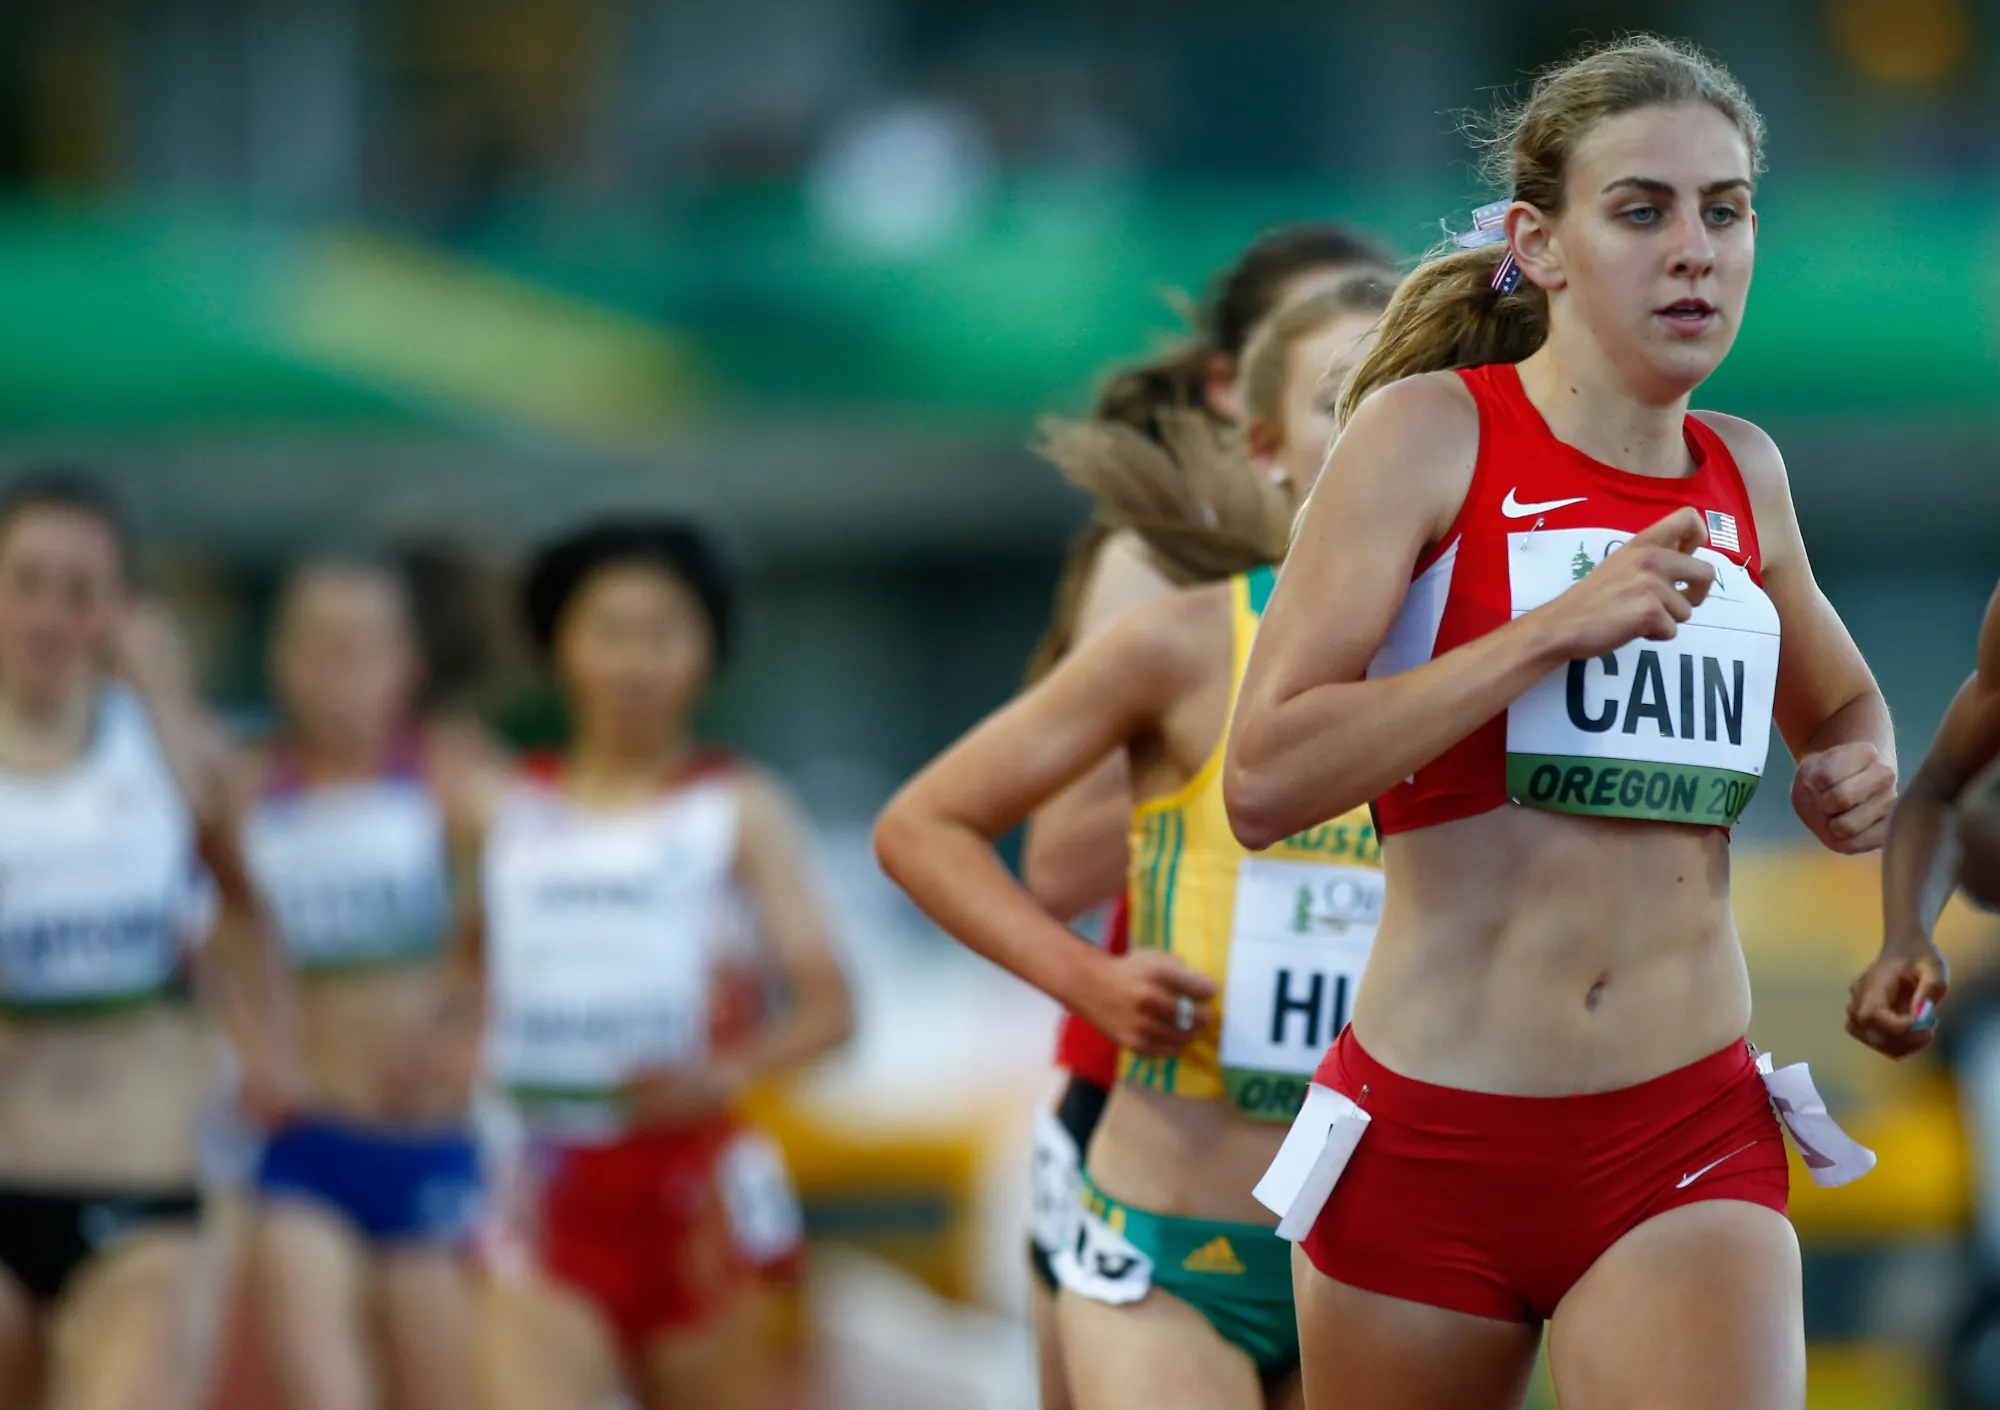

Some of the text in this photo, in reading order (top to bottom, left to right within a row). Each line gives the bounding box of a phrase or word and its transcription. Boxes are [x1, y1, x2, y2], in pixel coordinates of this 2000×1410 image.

[1566, 649, 1744, 746] CAIN
[1528, 764, 1699, 813] OREGON
[1284, 824, 1381, 862] ust
